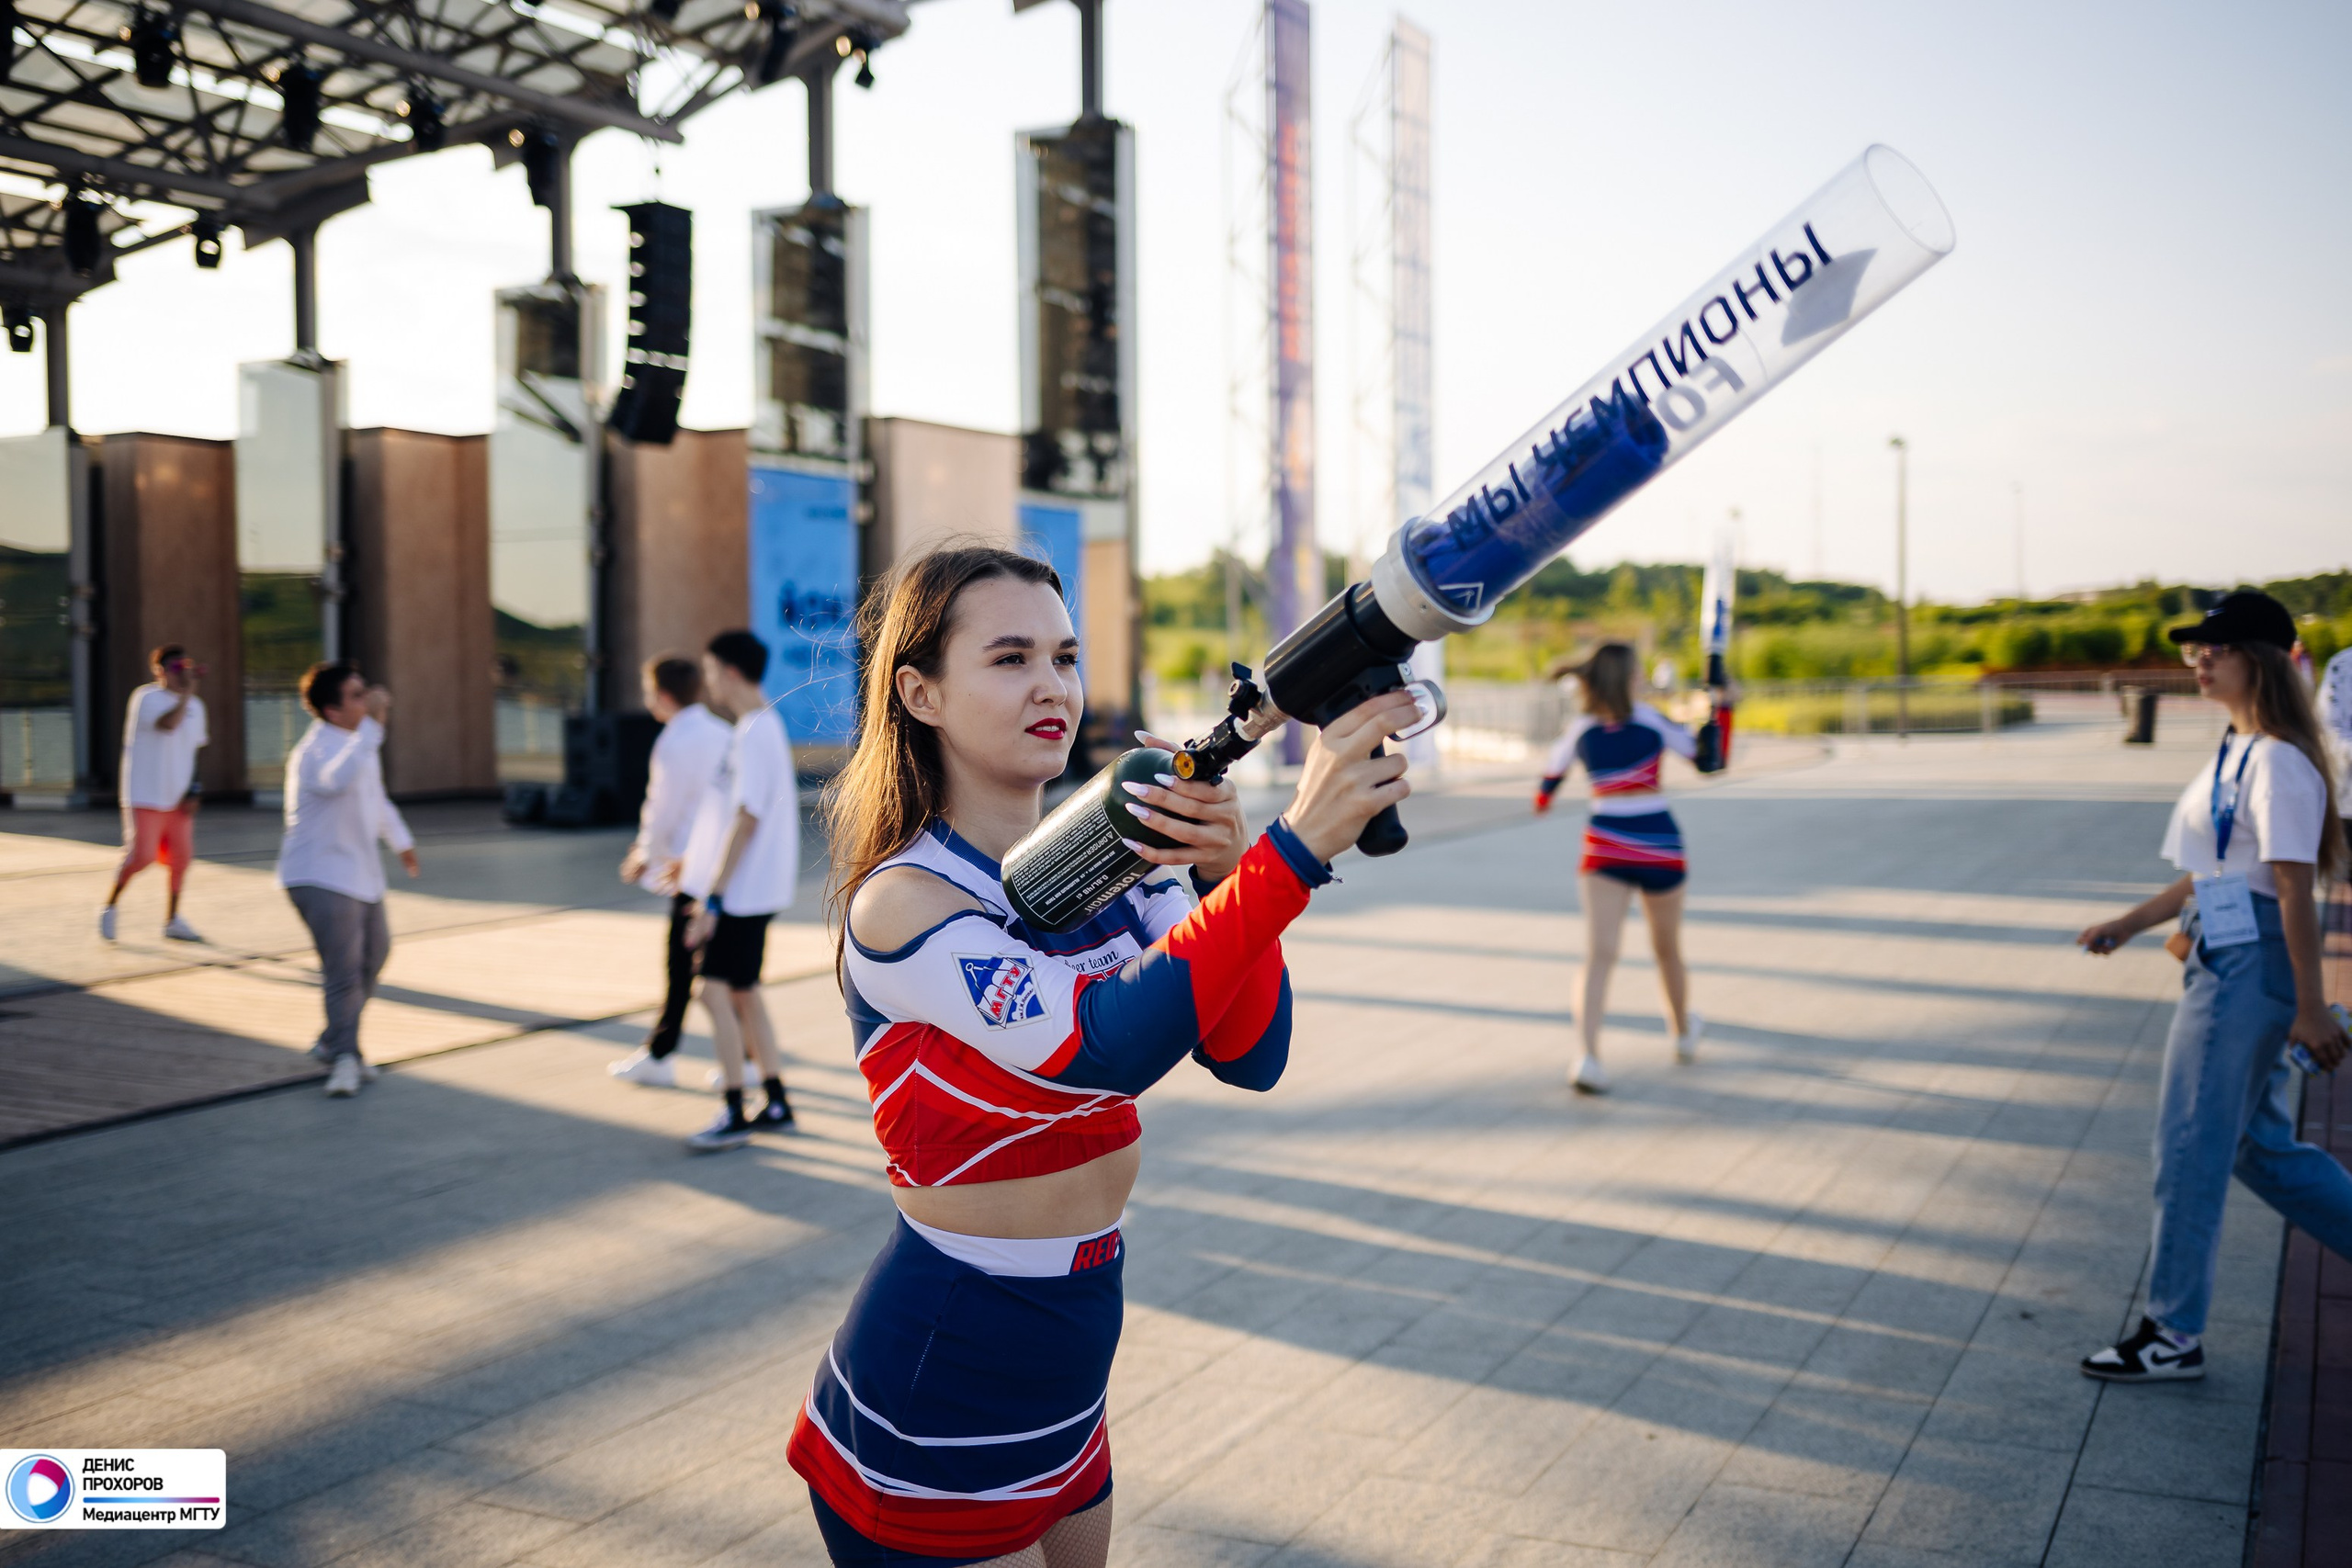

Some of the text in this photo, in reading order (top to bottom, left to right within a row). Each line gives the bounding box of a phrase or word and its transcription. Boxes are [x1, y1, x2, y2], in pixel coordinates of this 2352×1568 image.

[1448, 220, 1833, 551] МЫ ЧЕМПИОНЫ
[1087, 838, 1109, 855] DANGER
[1088, 950, 1119, 970] team
[989, 965, 1020, 1019] МГТУ
